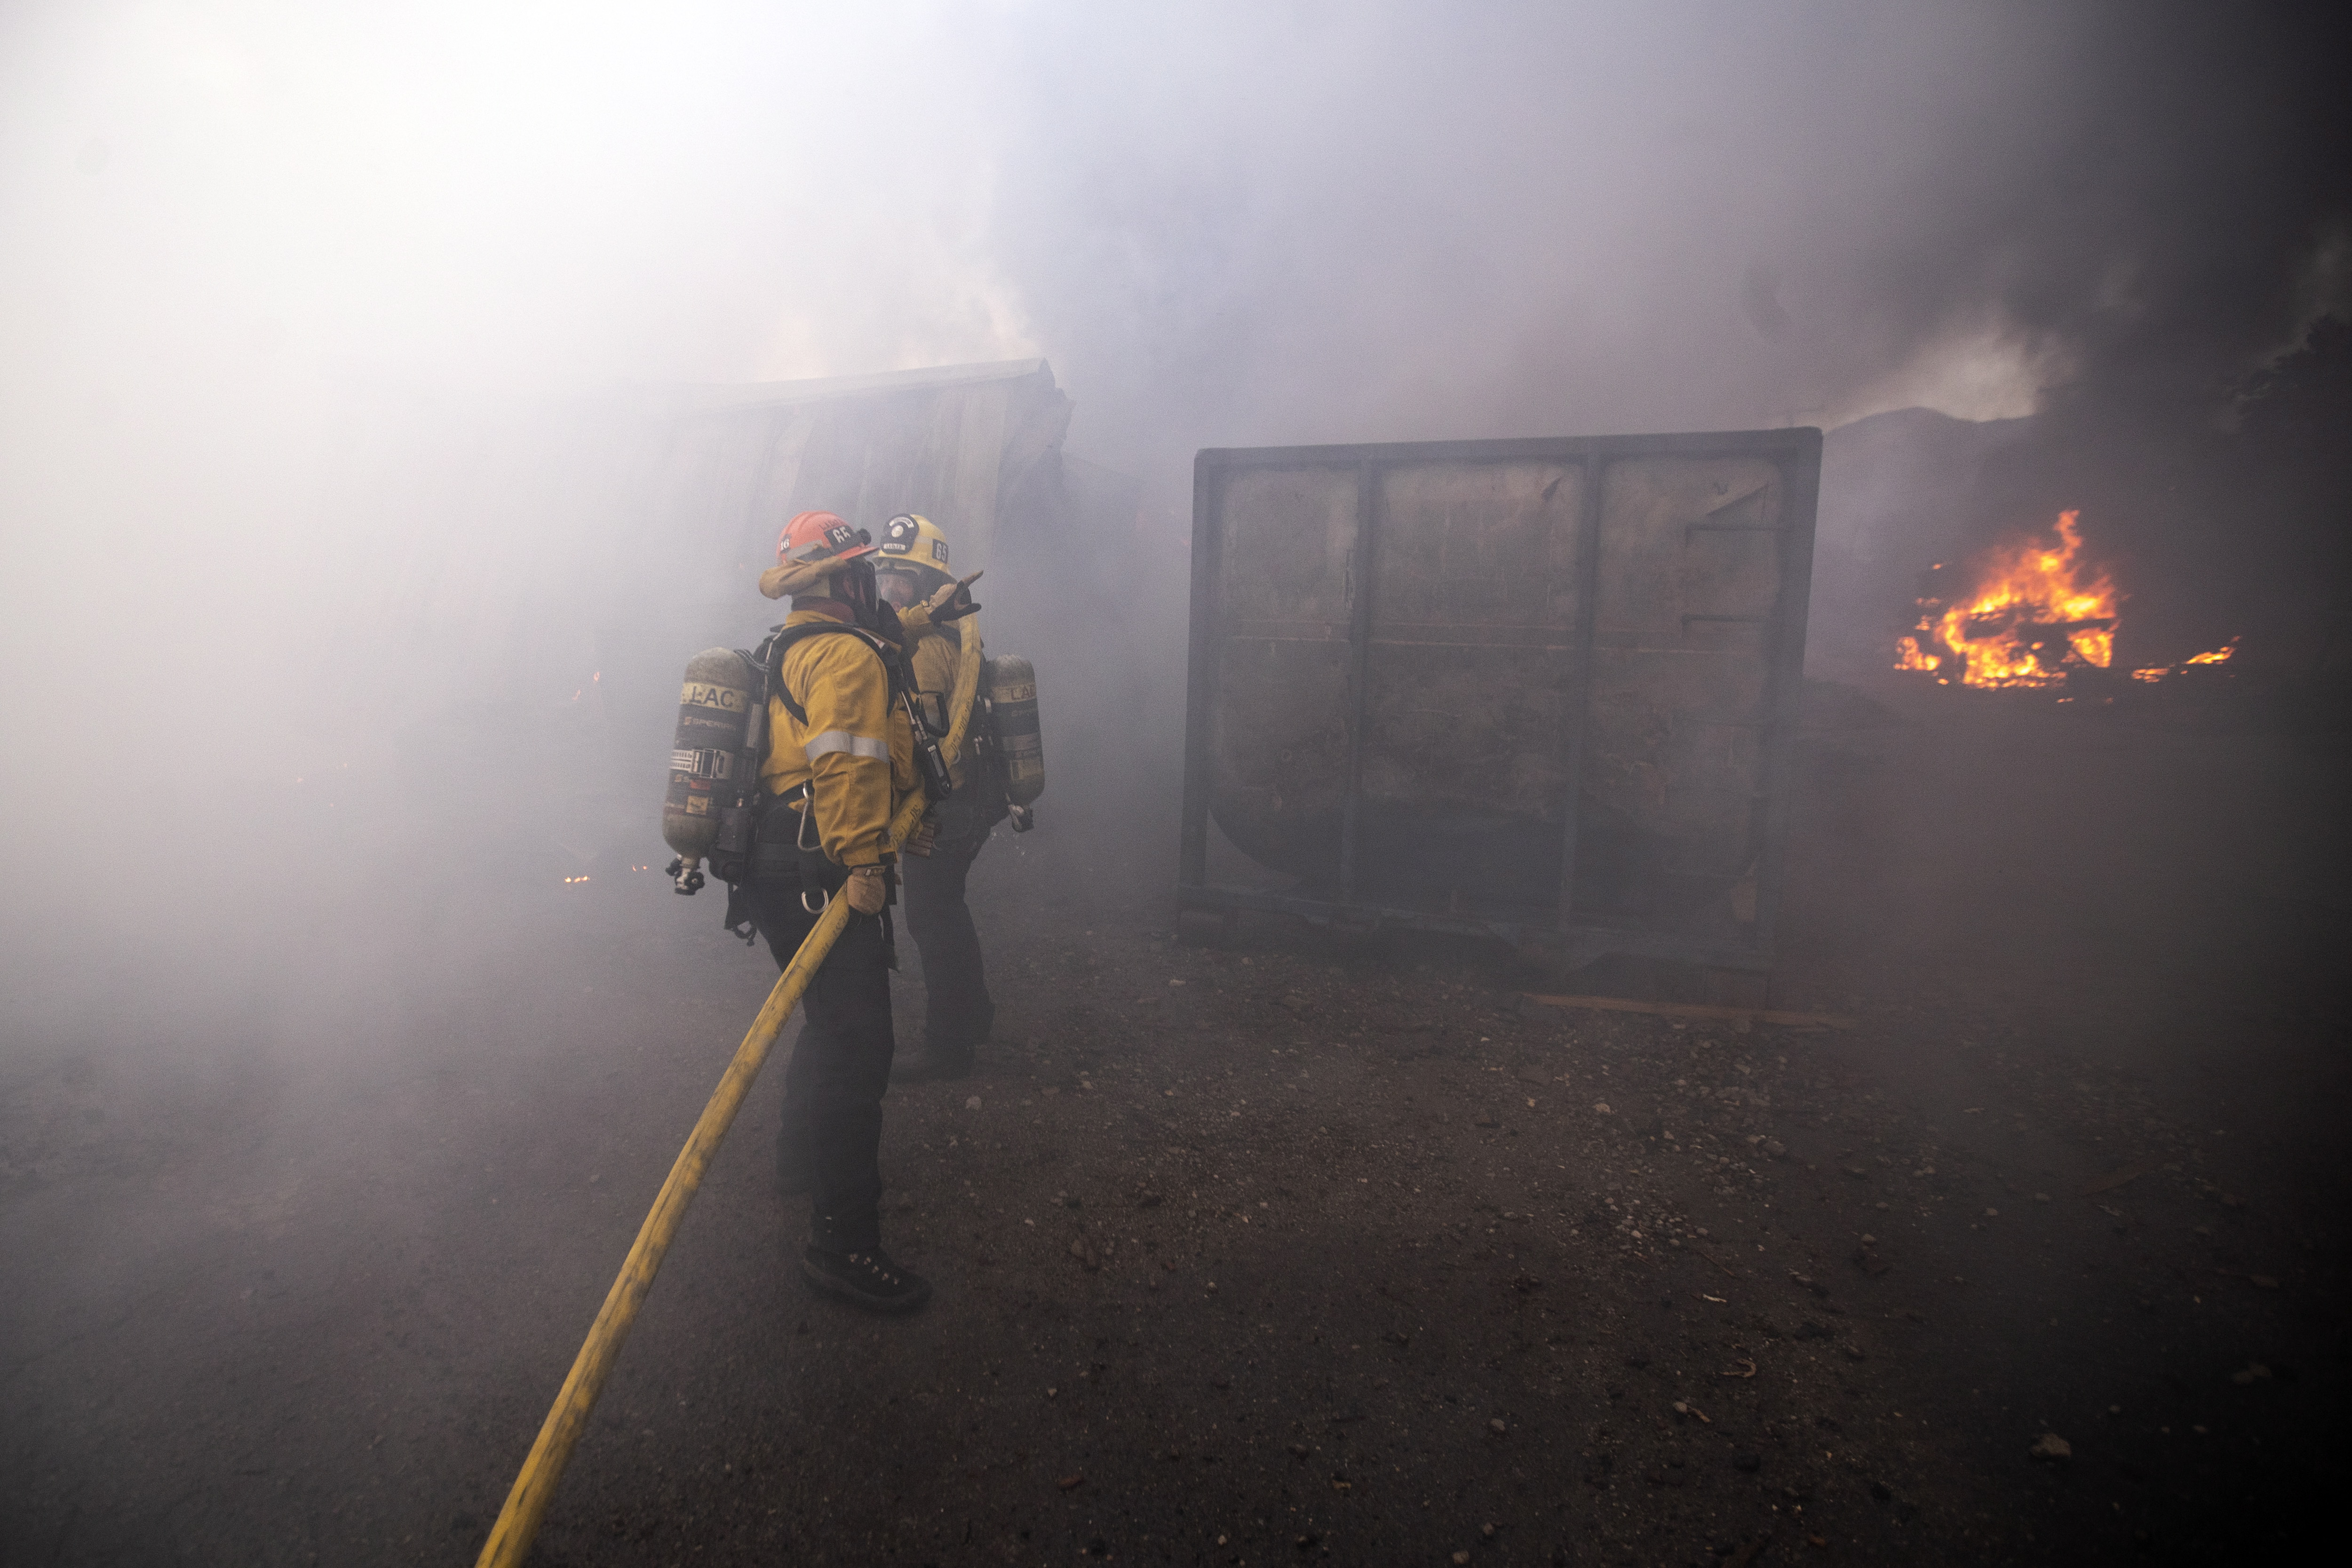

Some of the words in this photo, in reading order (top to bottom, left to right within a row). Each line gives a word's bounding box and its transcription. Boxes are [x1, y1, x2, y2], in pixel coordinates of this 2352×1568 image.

[832, 526, 850, 543] 65
[780, 539, 789, 551] 16
[936, 543, 947, 561] 65
[690, 686, 734, 708] LAC
